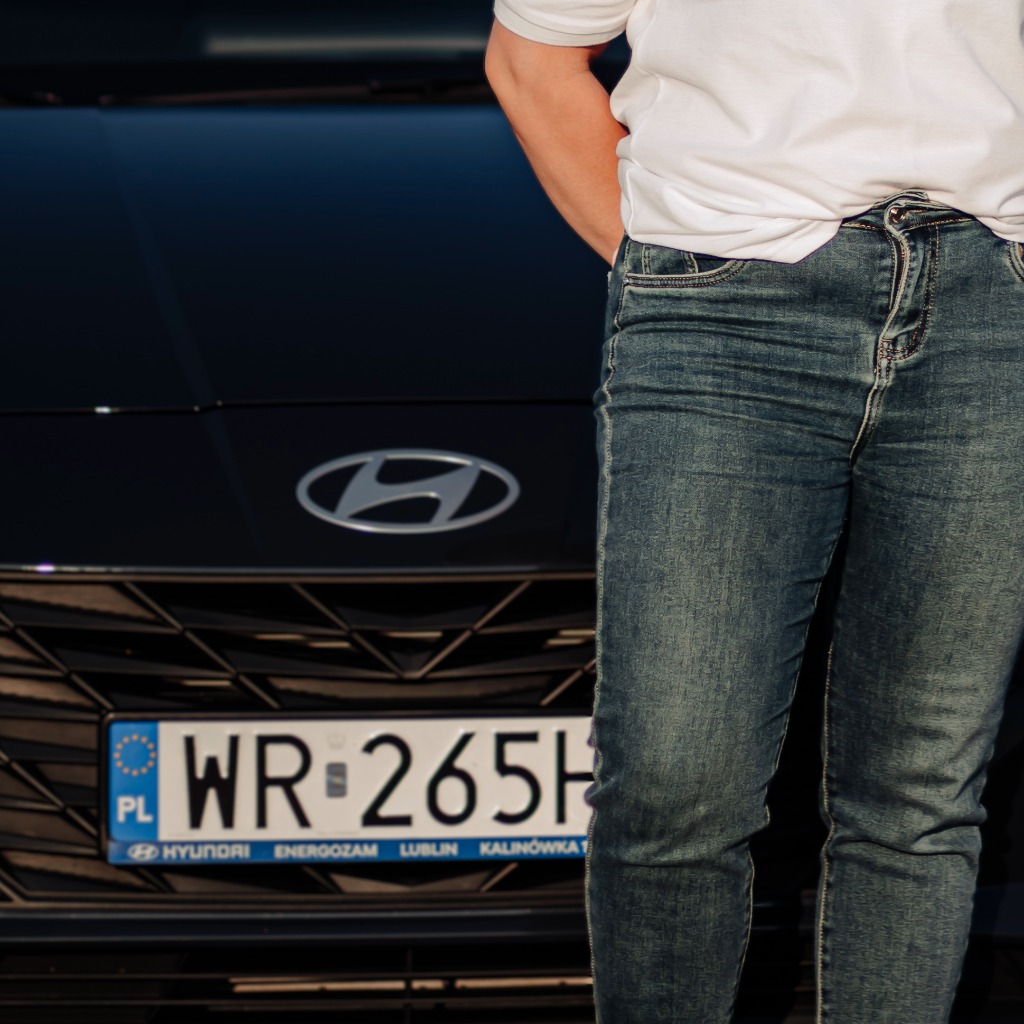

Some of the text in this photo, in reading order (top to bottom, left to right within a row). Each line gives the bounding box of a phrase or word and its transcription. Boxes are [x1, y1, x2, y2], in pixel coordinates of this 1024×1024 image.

[183, 730, 595, 830] WR 265H
[116, 796, 152, 823] PL
[163, 844, 249, 859] HYUNDAI
[274, 843, 378, 859] ENERGOZAM
[399, 842, 458, 858] LUBLIN
[479, 838, 580, 856] KALINÓWKA
